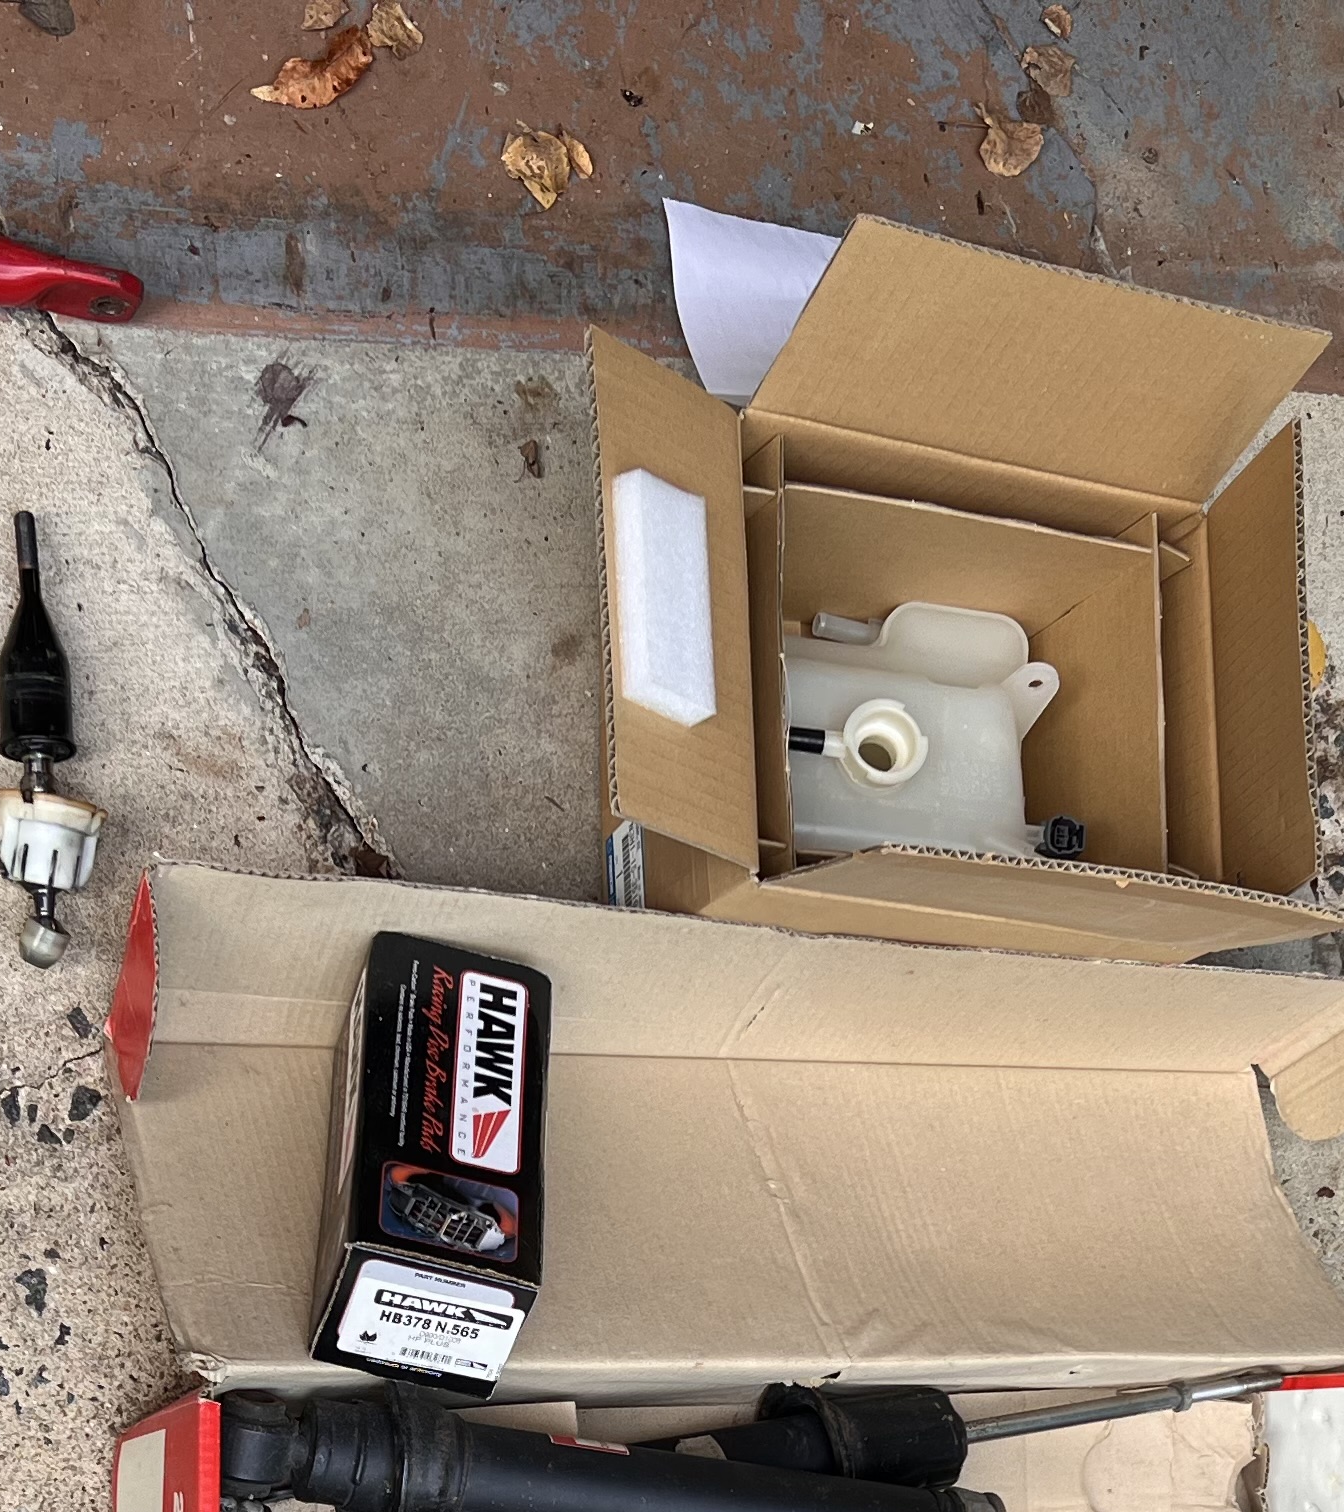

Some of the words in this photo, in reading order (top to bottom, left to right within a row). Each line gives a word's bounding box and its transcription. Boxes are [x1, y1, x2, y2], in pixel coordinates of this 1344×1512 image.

[422, 964, 454, 1026] Racing
[426, 1022, 450, 1064] Disc
[457, 979, 476, 1156] PERFORMANCE
[472, 982, 518, 1107] HAWK
[423, 1060, 447, 1114] Brake
[420, 1110, 444, 1154] Pads
[379, 1310, 432, 1330] HB378
[434, 1320, 480, 1340] N.565
[380, 1291, 471, 1321] HAWK
